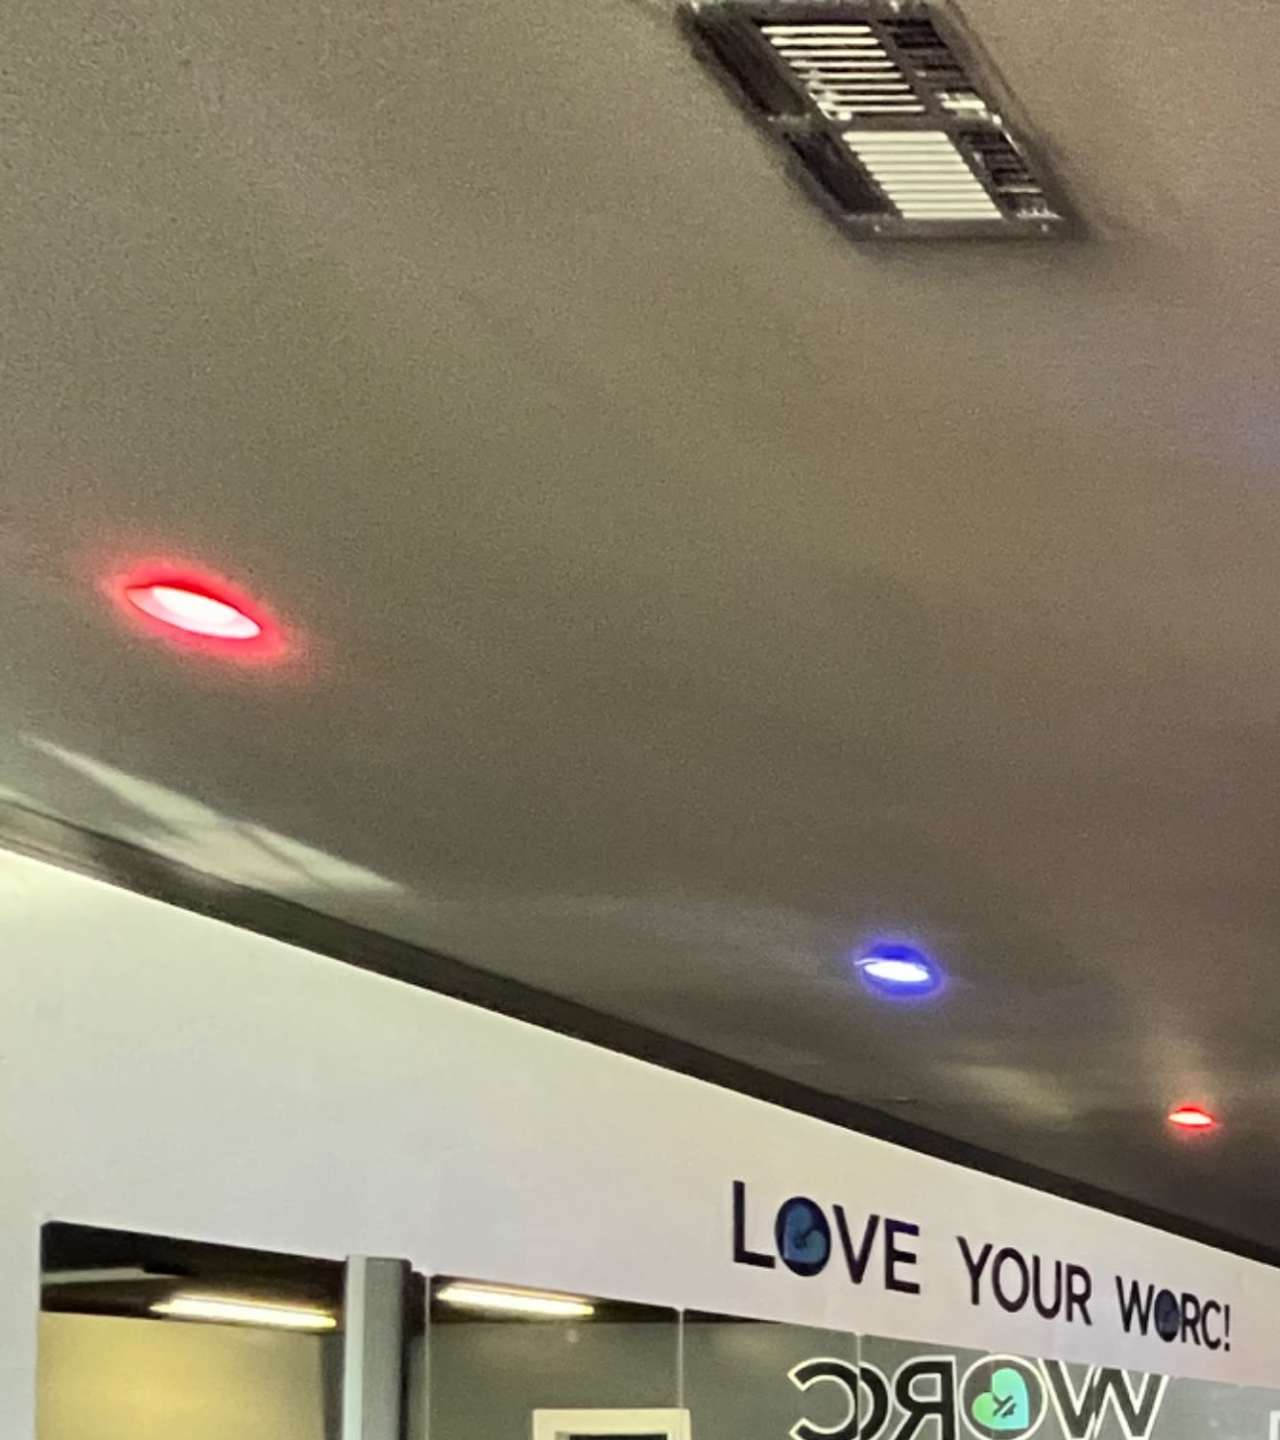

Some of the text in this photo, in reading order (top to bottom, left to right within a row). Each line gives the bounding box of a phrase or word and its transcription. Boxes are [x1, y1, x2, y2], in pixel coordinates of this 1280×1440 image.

[732, 1180, 1232, 1353] LOVE YOUR WORC!
